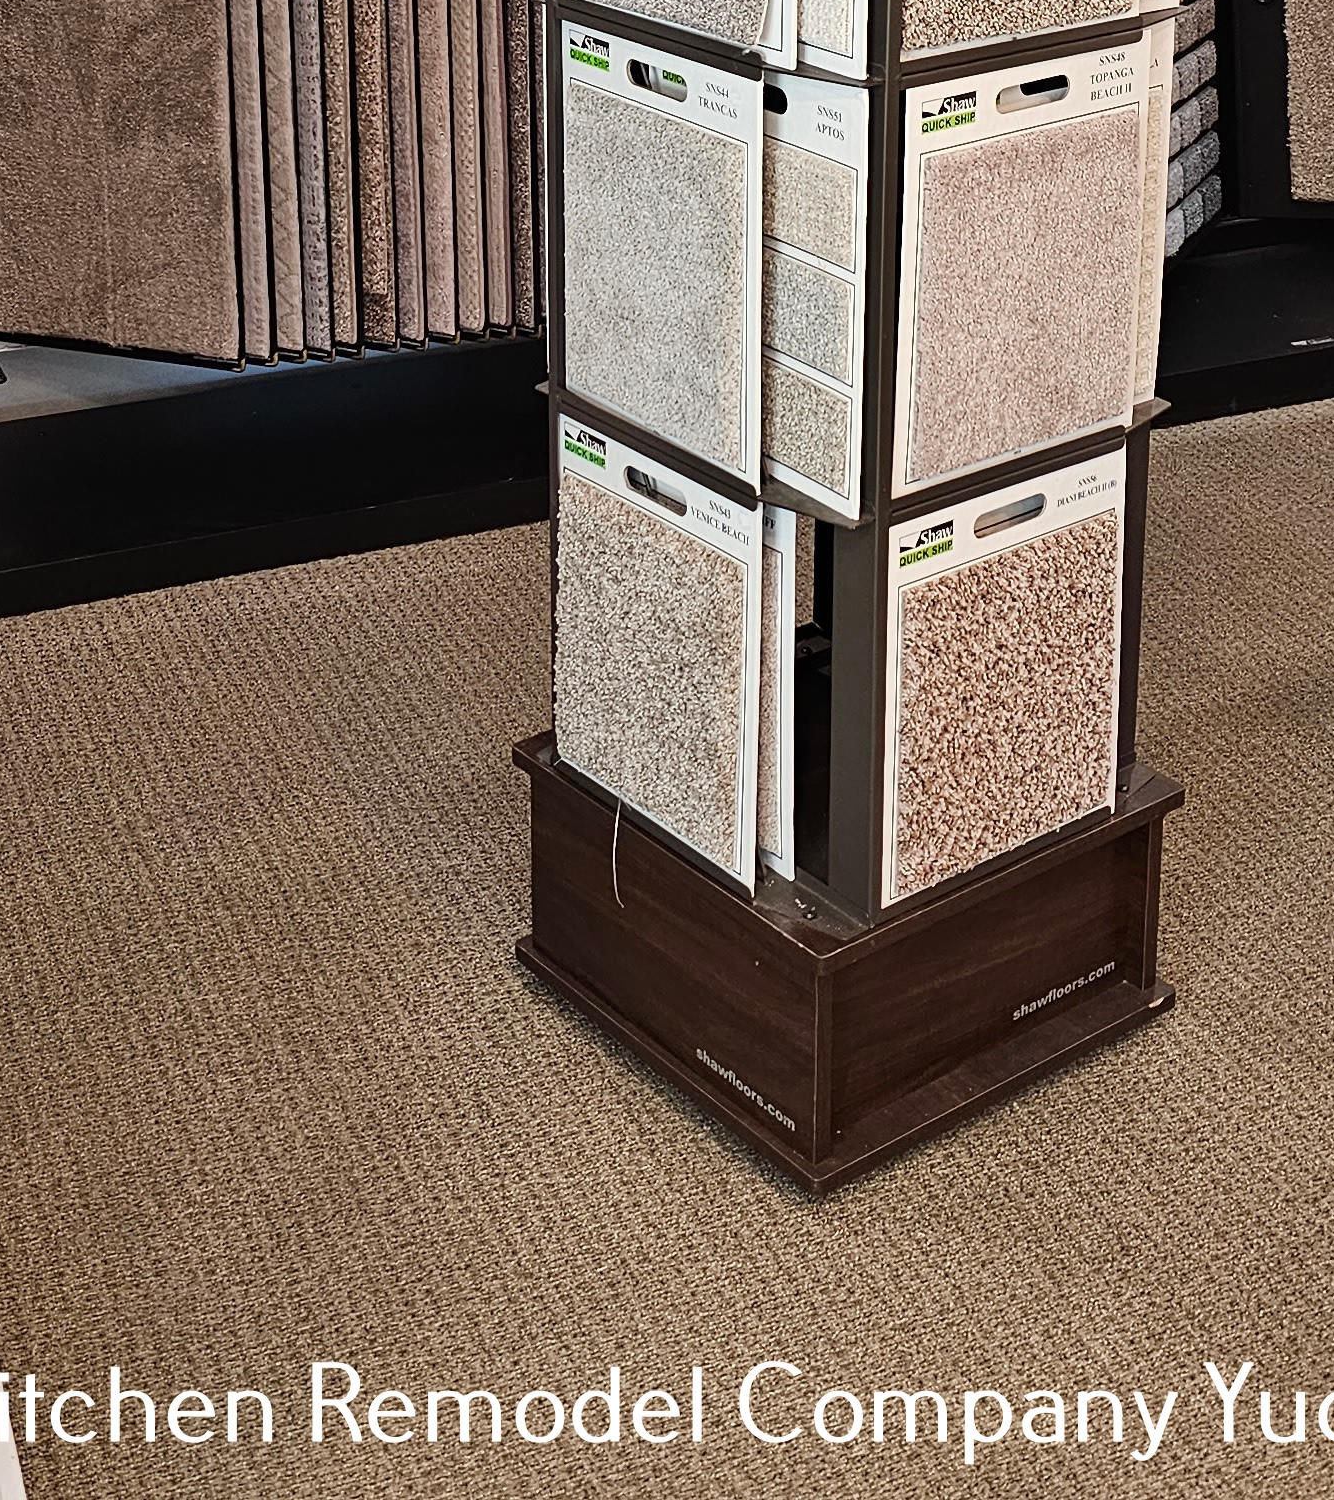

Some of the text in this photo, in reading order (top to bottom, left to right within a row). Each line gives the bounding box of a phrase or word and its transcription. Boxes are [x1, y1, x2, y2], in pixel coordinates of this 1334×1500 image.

[584, 37, 611, 59] Shaw
[570, 48, 611, 71] QUICK SHIP
[1090, 67, 1135, 85] TOPANGA
[1090, 85, 1123, 101] BEACH
[698, 95, 738, 120] TRANCAS
[816, 103, 842, 124] SNS51
[943, 97, 976, 114] Shaw
[816, 122, 846, 142] APTOS
[921, 111, 976, 133] QUICK SHIP
[564, 439, 606, 467] QUICK SHIP
[580, 432, 607, 457] Shaw
[691, 506, 720, 531] VENICE
[722, 521, 749, 546] BEACH
[920, 526, 953, 546] Shaw
[899, 540, 953, 567] QUICK SHIP
[1012, 959, 1115, 1021] shawfloors.com
[696, 1046, 796, 1132] shawfloors.com
